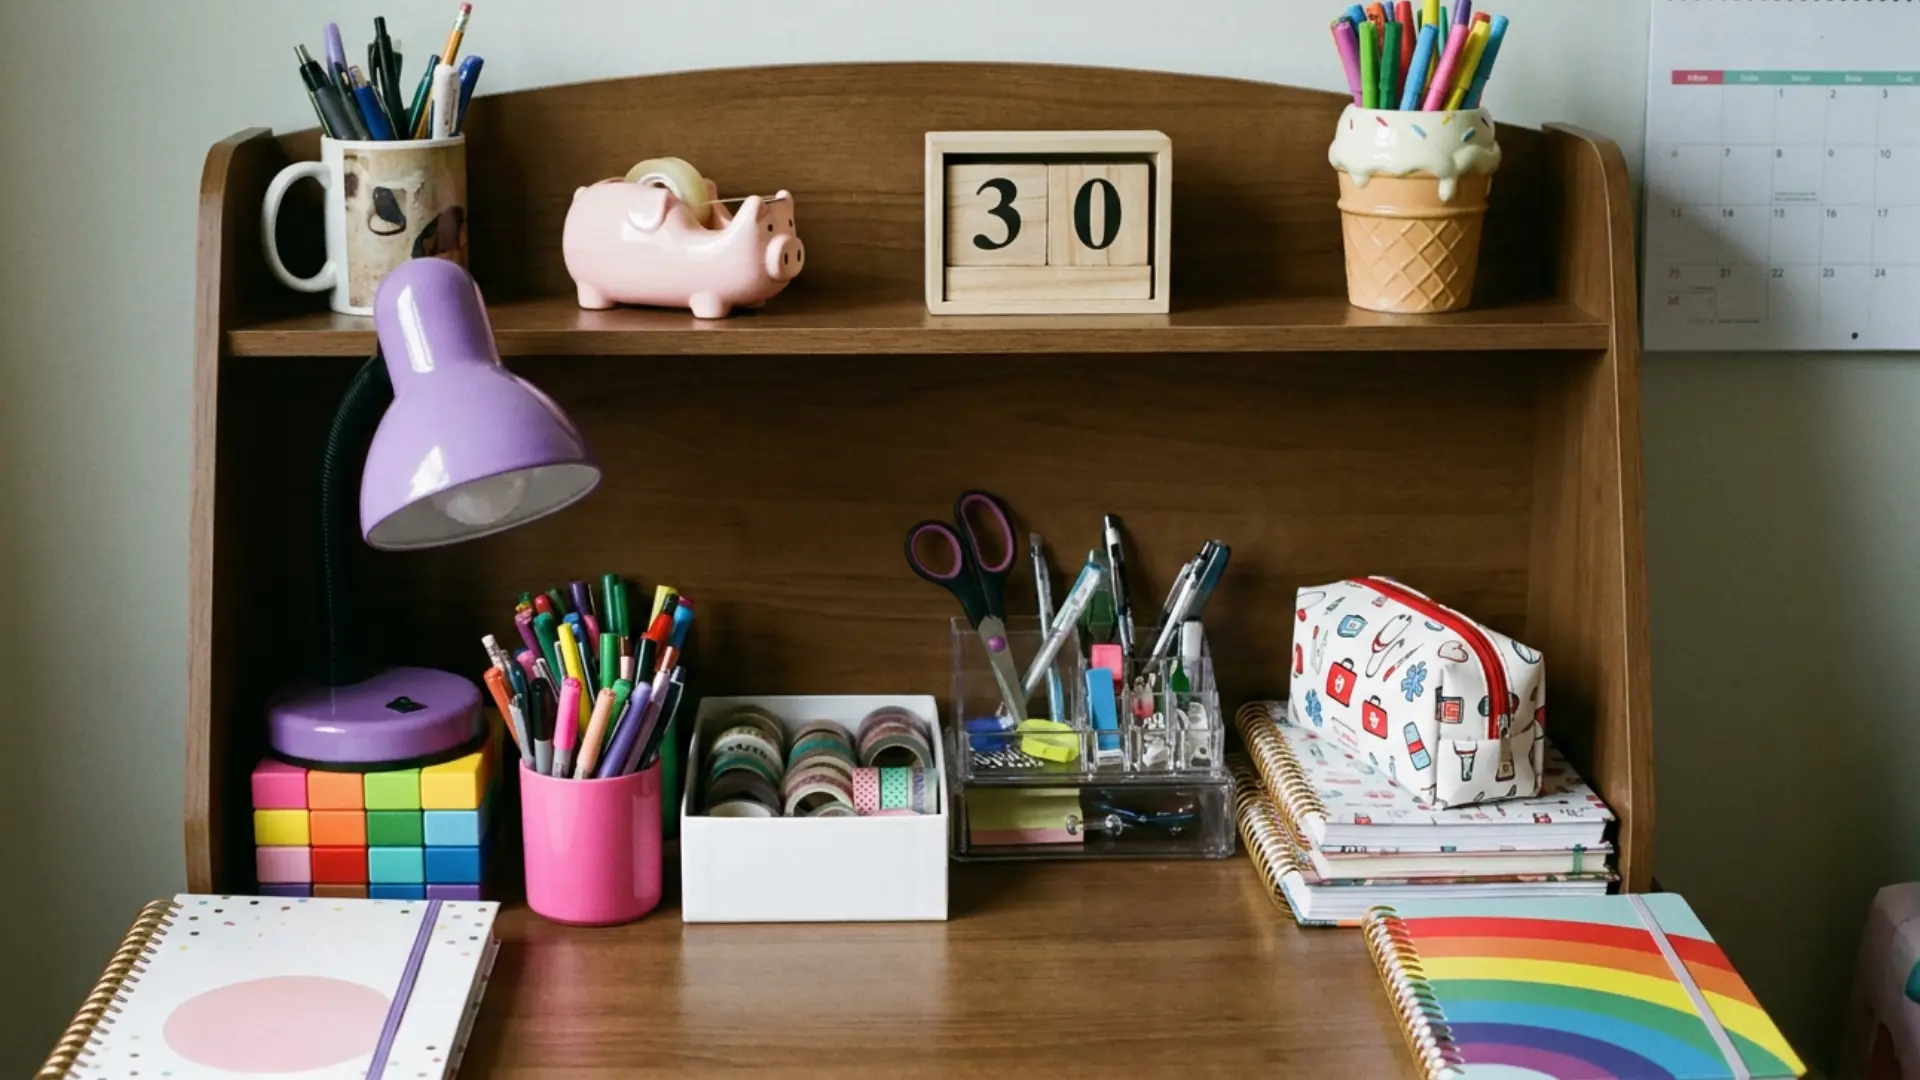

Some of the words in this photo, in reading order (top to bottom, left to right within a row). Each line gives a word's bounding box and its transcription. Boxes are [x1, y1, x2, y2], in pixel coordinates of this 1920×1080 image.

[1778, 88, 1785, 99] 1
[1829, 88, 1837, 100] 2
[1881, 88, 1889, 100] 3
[1724, 147, 1732, 158] 7
[1775, 148, 1783, 159] 8
[1879, 148, 1892, 160] 10
[1722, 208, 1735, 218] 14
[1826, 208, 1838, 219] 16
[1877, 208, 1889, 218] 17
[1719, 267, 1732, 279] 21
[1770, 267, 1785, 279] 22
[1822, 267, 1836, 278] 23
[1874, 267, 1887, 279] 24
